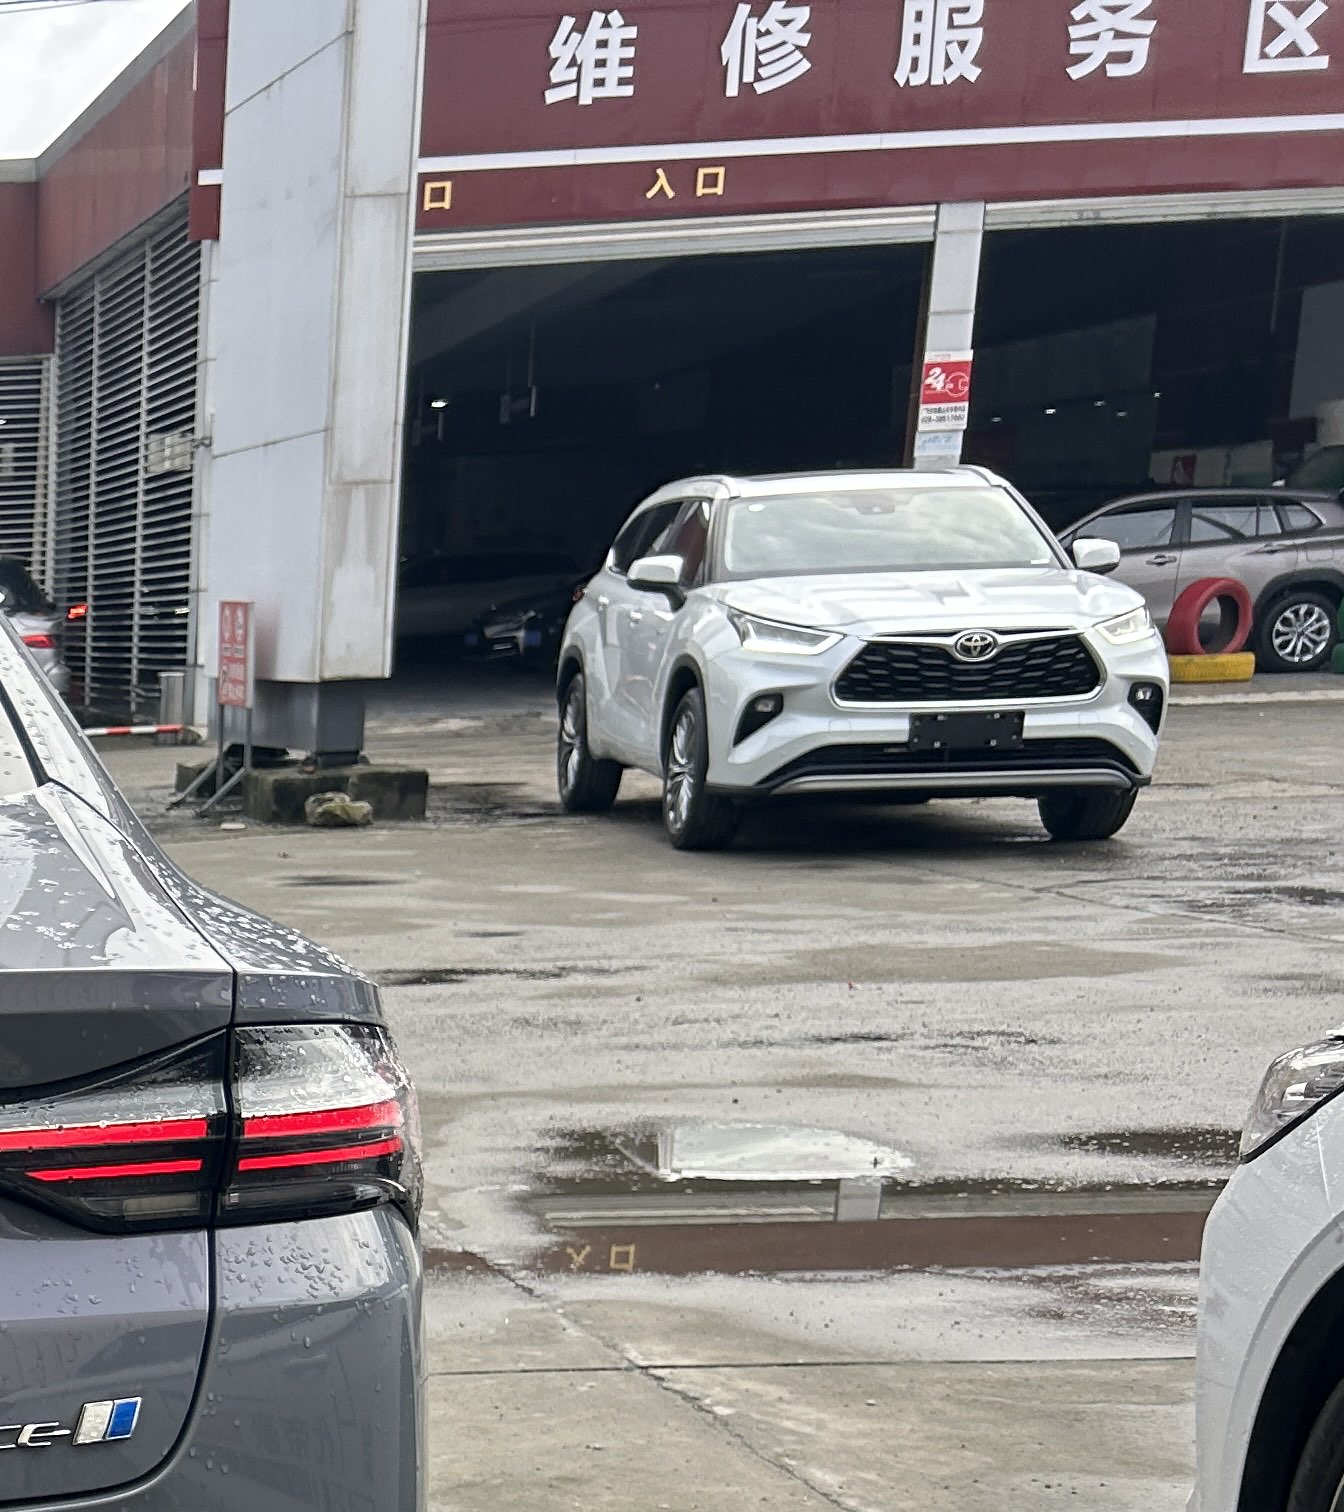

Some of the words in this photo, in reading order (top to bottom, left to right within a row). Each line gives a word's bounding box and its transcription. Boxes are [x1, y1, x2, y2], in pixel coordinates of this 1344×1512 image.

[544, 0, 1330, 105] 维修服务区
[645, 166, 726, 200] 入口
